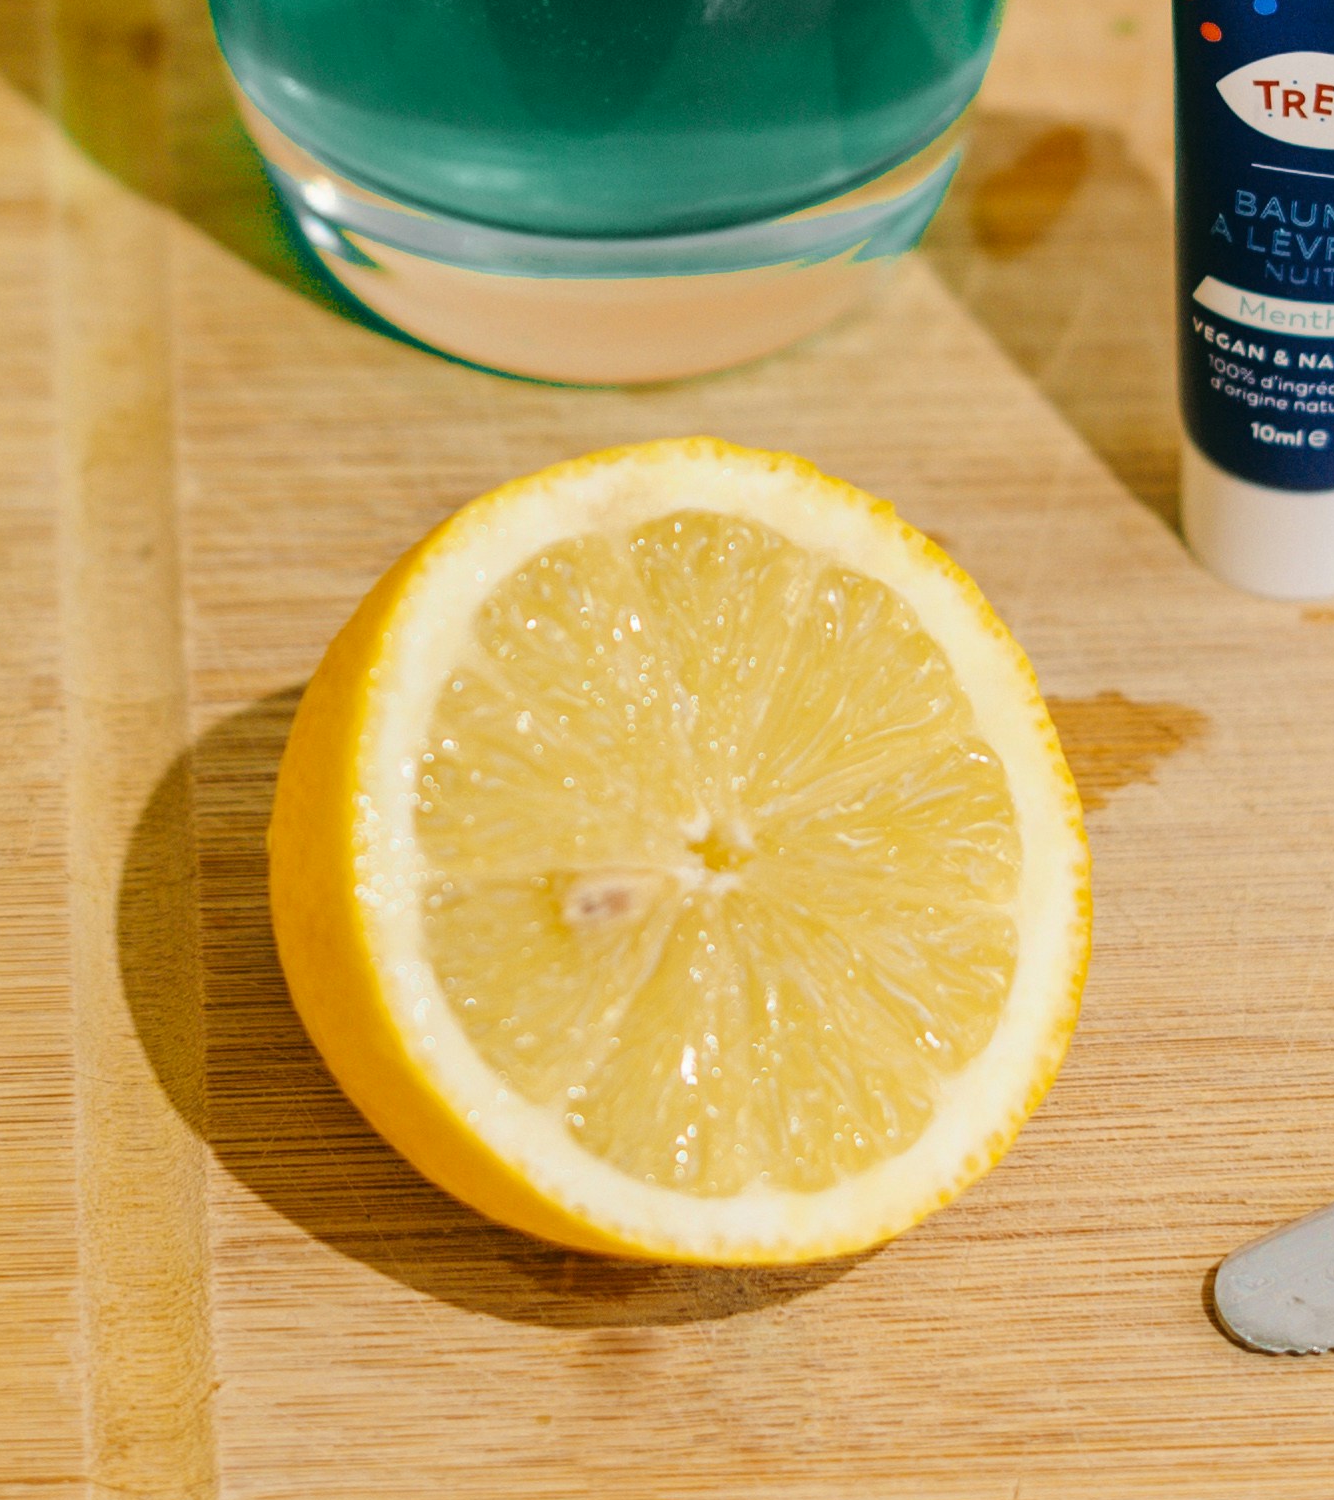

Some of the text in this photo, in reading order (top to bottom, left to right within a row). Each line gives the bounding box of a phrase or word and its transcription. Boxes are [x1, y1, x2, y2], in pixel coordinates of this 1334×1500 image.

[1192, 315, 1266, 362] VEGAN
[1273, 350, 1290, 367] &
[1208, 353, 1256, 385] 100%
[1210, 376, 1289, 410] d'origine
[1250, 421, 1303, 447] 10ml
